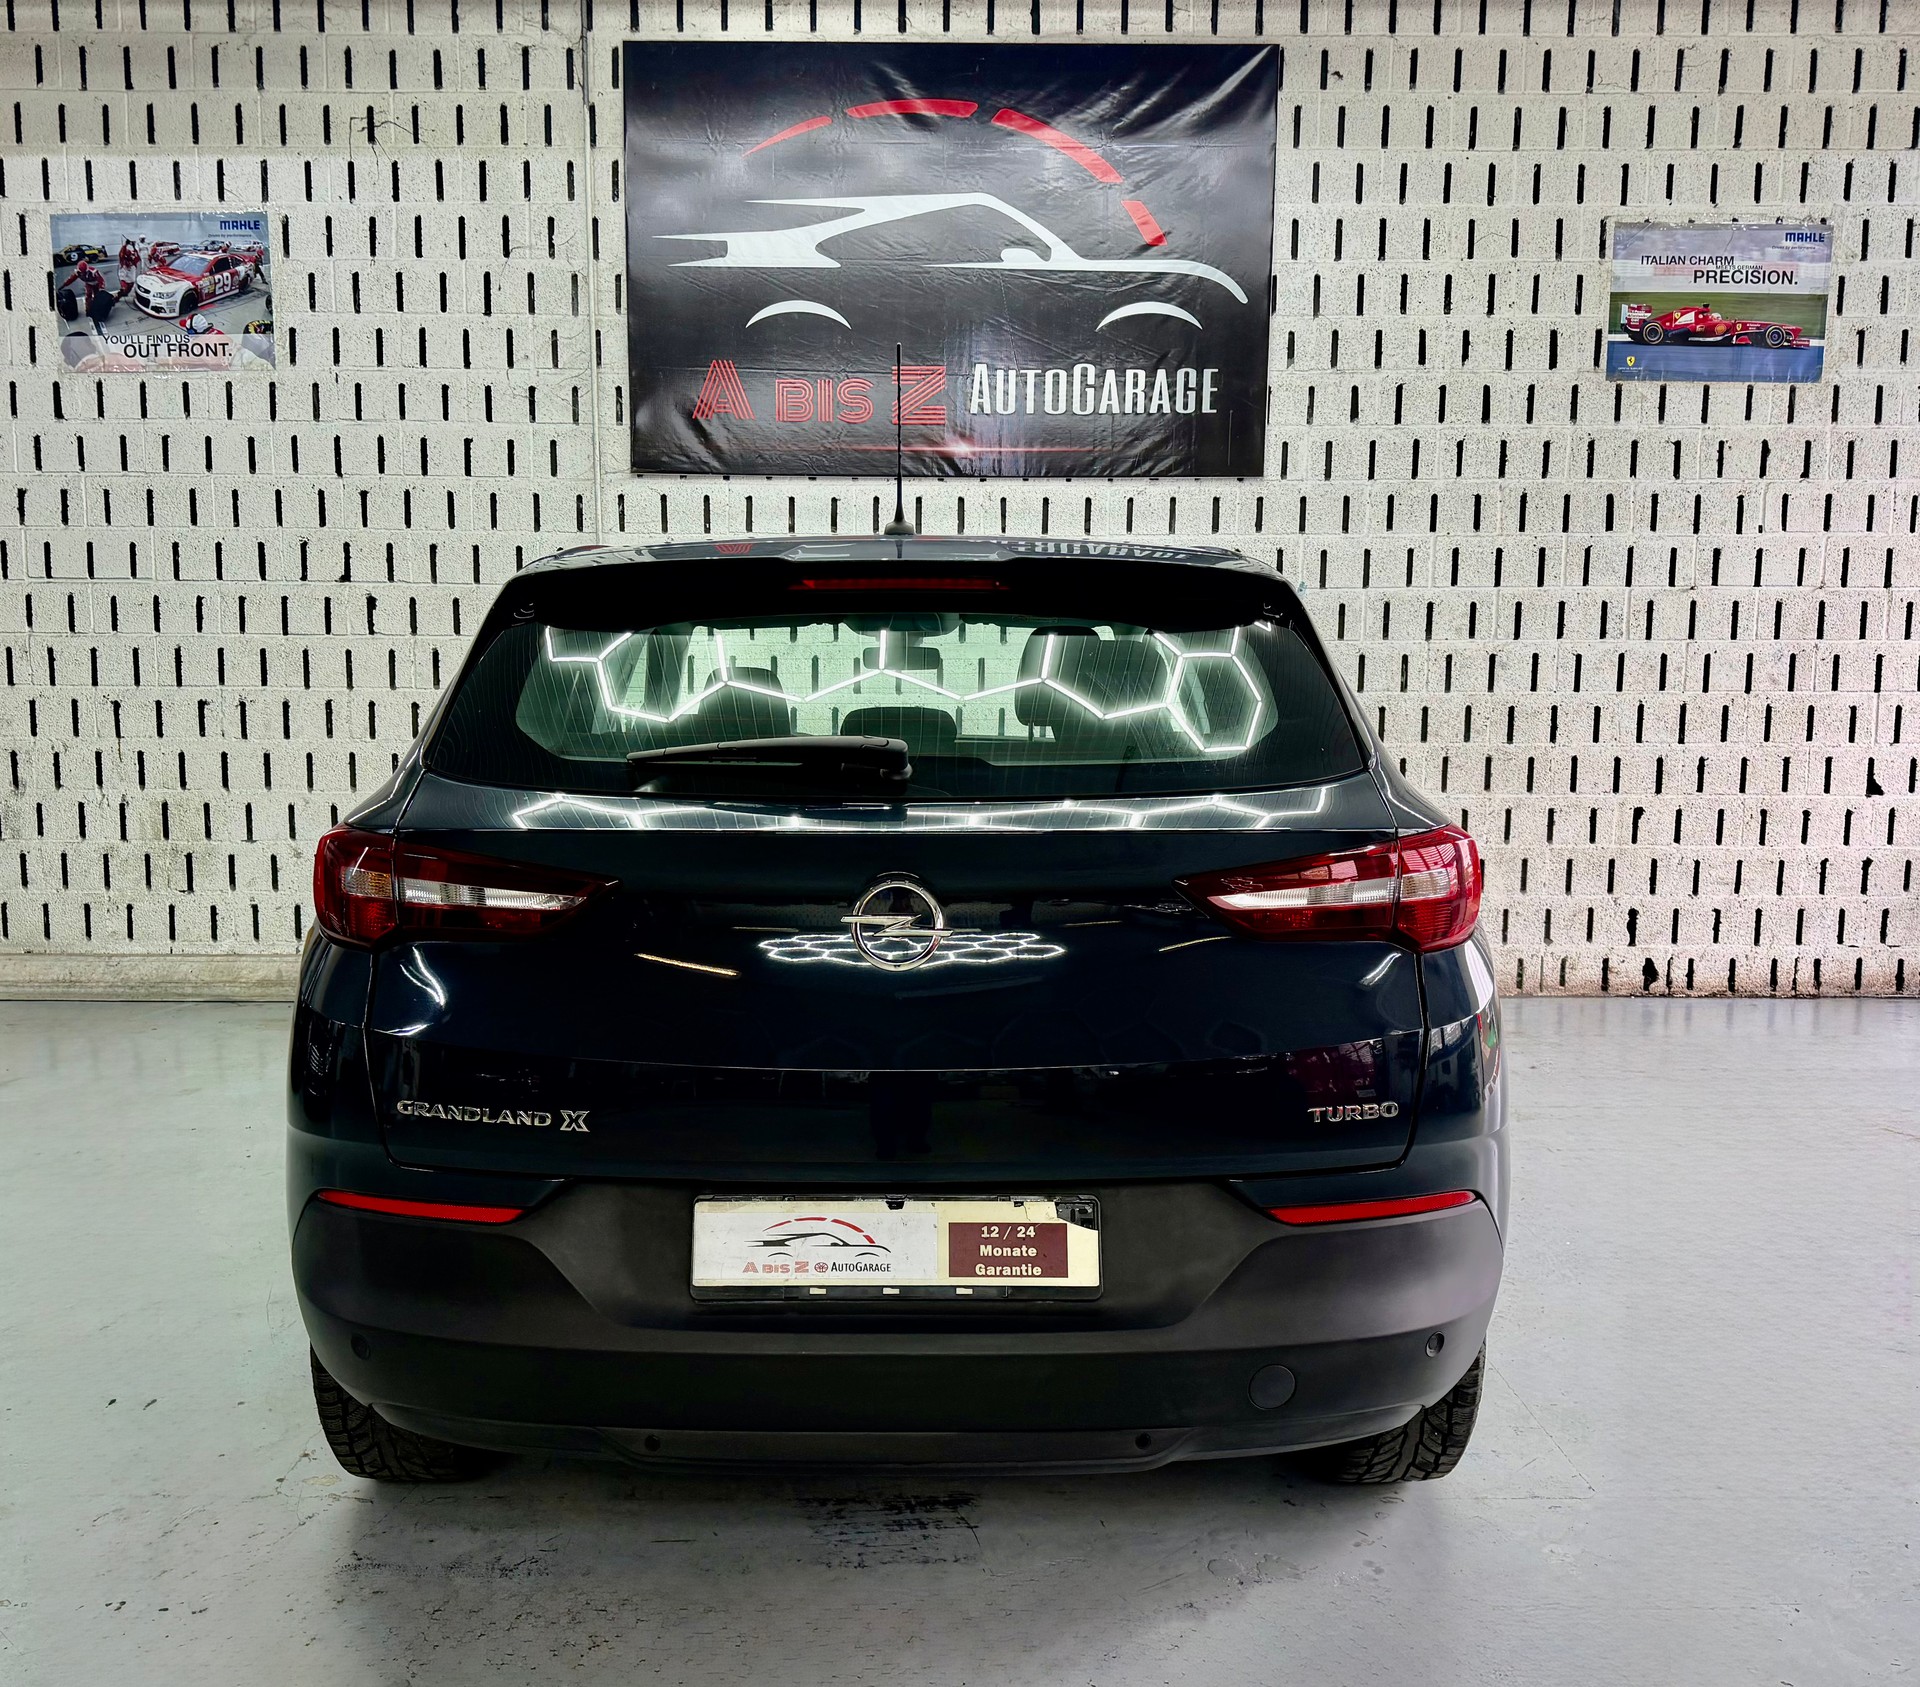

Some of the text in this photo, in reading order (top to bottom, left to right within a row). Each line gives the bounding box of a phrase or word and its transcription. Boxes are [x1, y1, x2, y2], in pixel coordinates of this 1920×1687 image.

[219, 220, 261, 230] MAHLE
[1785, 232, 1826, 243] MAHLE
[1641, 256, 1734, 266] ITALIAN CHARM
[214, 273, 232, 294] 29
[1693, 269, 1799, 285] PRECISION.
[104, 334, 191, 345] YOU'LL FIND US
[123, 342, 233, 358] OUT FRONT.
[692, 359, 756, 420] A
[775, 377, 875, 425] BIS
[891, 365, 947, 425] Z
[396, 1099, 591, 1133] GRANDLAND X
[1307, 1101, 1399, 1123] TURBO
[981, 1225, 1000, 1238] 12
[1016, 1225, 1036, 1238] 24
[979, 1244, 1038, 1257] Monate
[742, 1261, 760, 1274] A
[794, 1260, 810, 1274] Z
[975, 1263, 1043, 1277] Garantie
